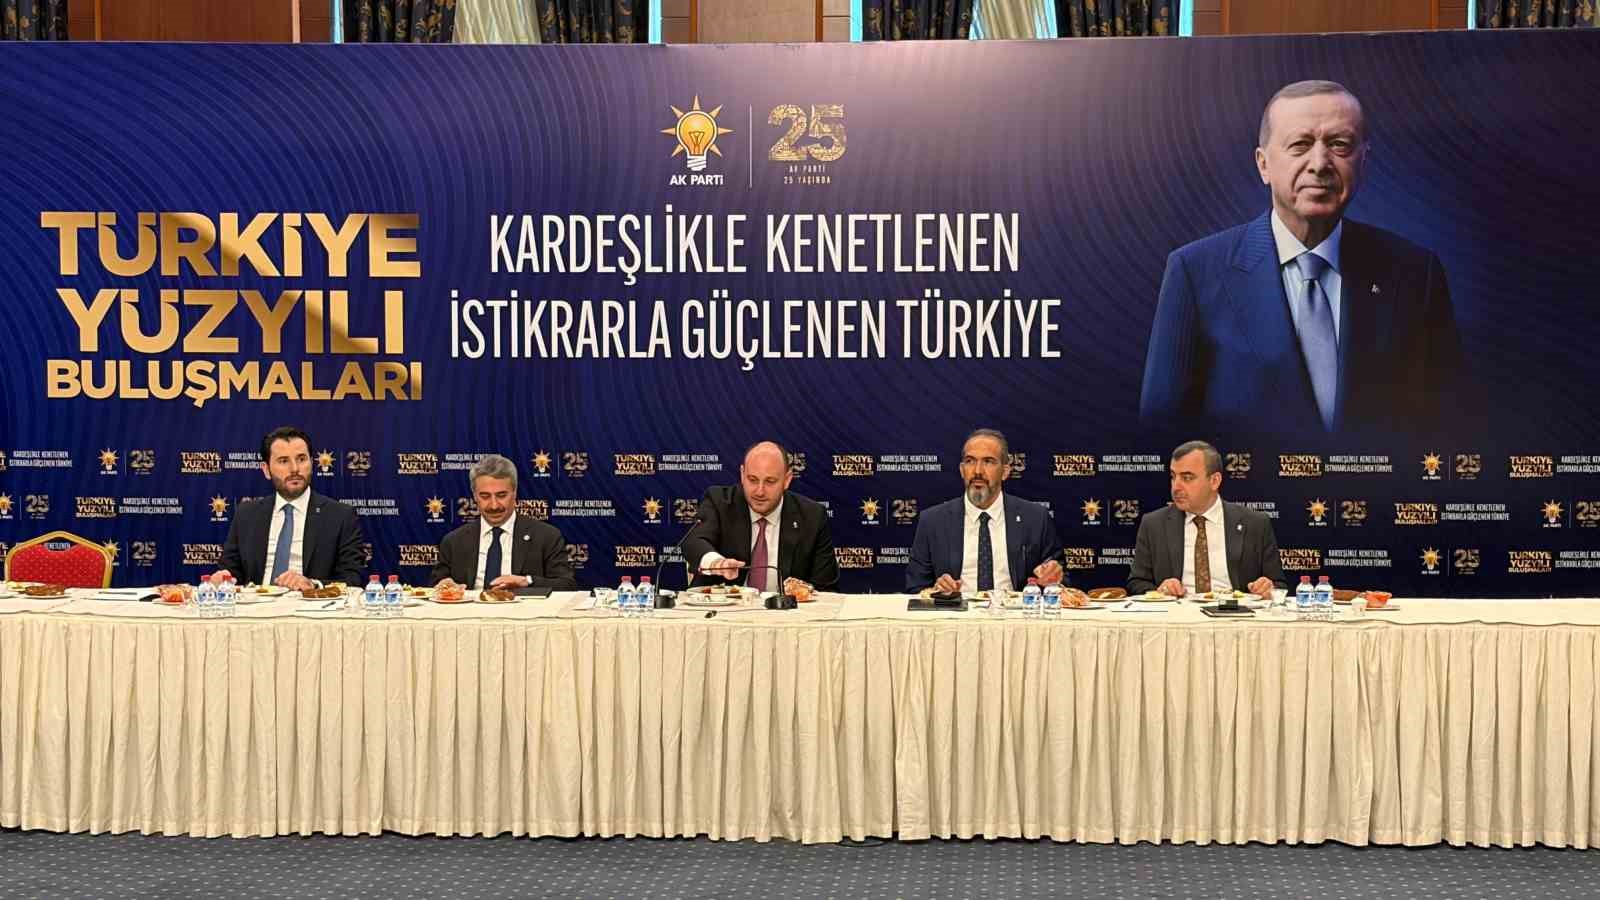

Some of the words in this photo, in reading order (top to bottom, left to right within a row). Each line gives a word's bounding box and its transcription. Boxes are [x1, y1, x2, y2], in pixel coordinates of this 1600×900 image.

[768, 104, 848, 162] 25
[670, 175, 687, 186] AK
[41, 212, 421, 278] TÜRKİYE
[490, 204, 747, 285] KARDEŞLİKLE
[767, 213, 1019, 272] KENETLENEN
[56, 288, 404, 354] YÜZYILI
[451, 290, 672, 358] İSTİKRARLA
[682, 289, 886, 370] GÜÇLENEN
[896, 289, 1062, 358] TÜRKİYE
[47, 359, 423, 408] BULUŞMALARI
